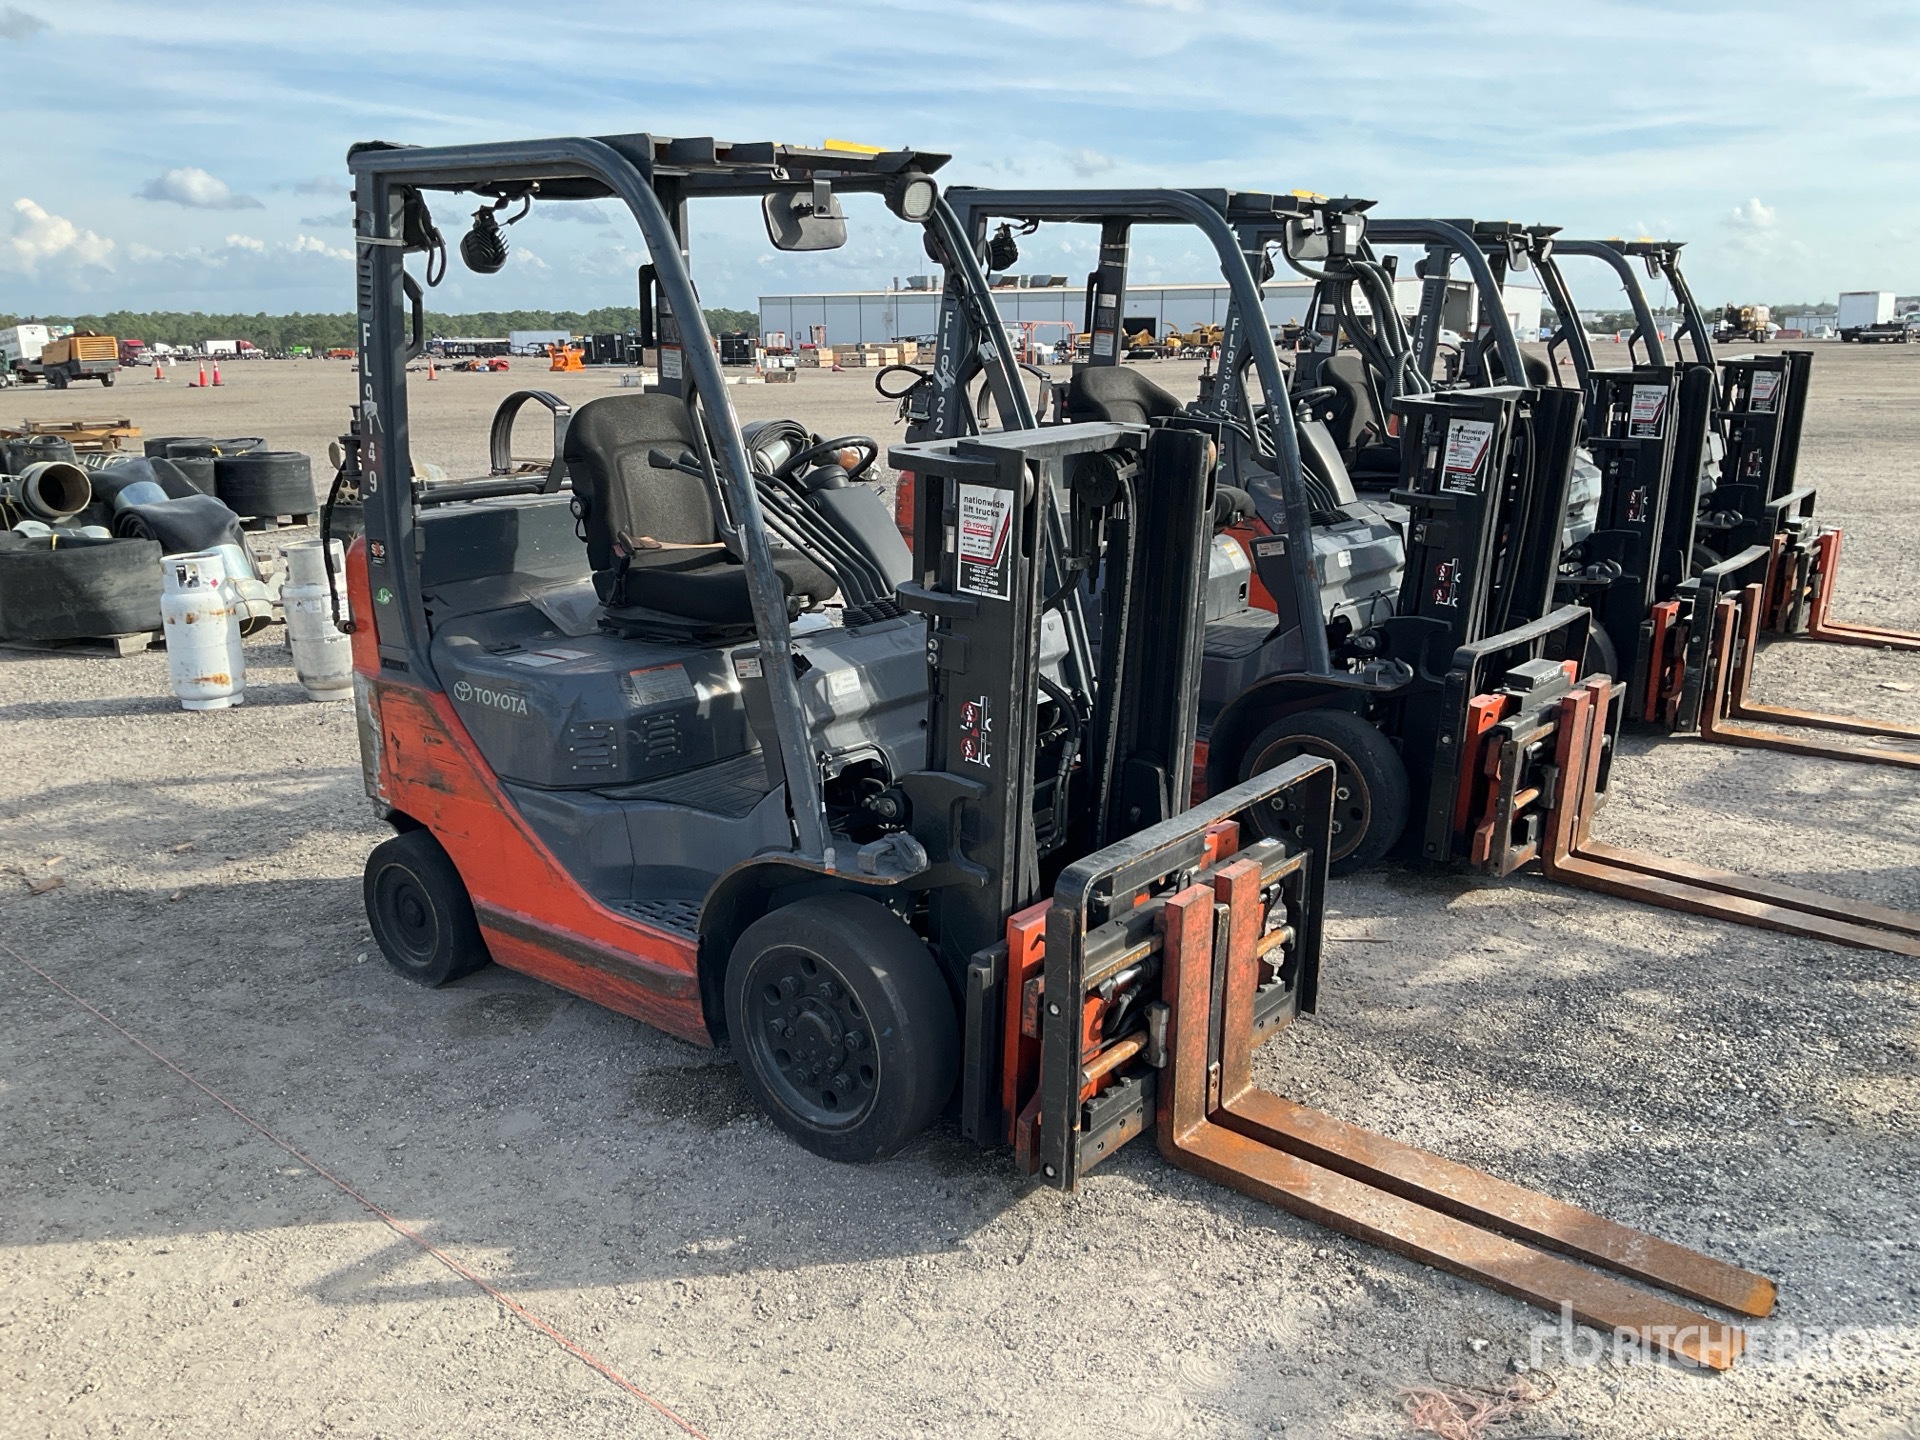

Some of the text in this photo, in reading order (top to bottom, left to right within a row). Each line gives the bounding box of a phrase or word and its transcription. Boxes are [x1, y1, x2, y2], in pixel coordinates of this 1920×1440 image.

[964, 495, 1005, 510] nationwide
[963, 504, 1000, 518] lift trucks
[972, 522, 993, 531] TOYOTA
[474, 687, 528, 715] TOYOTA
